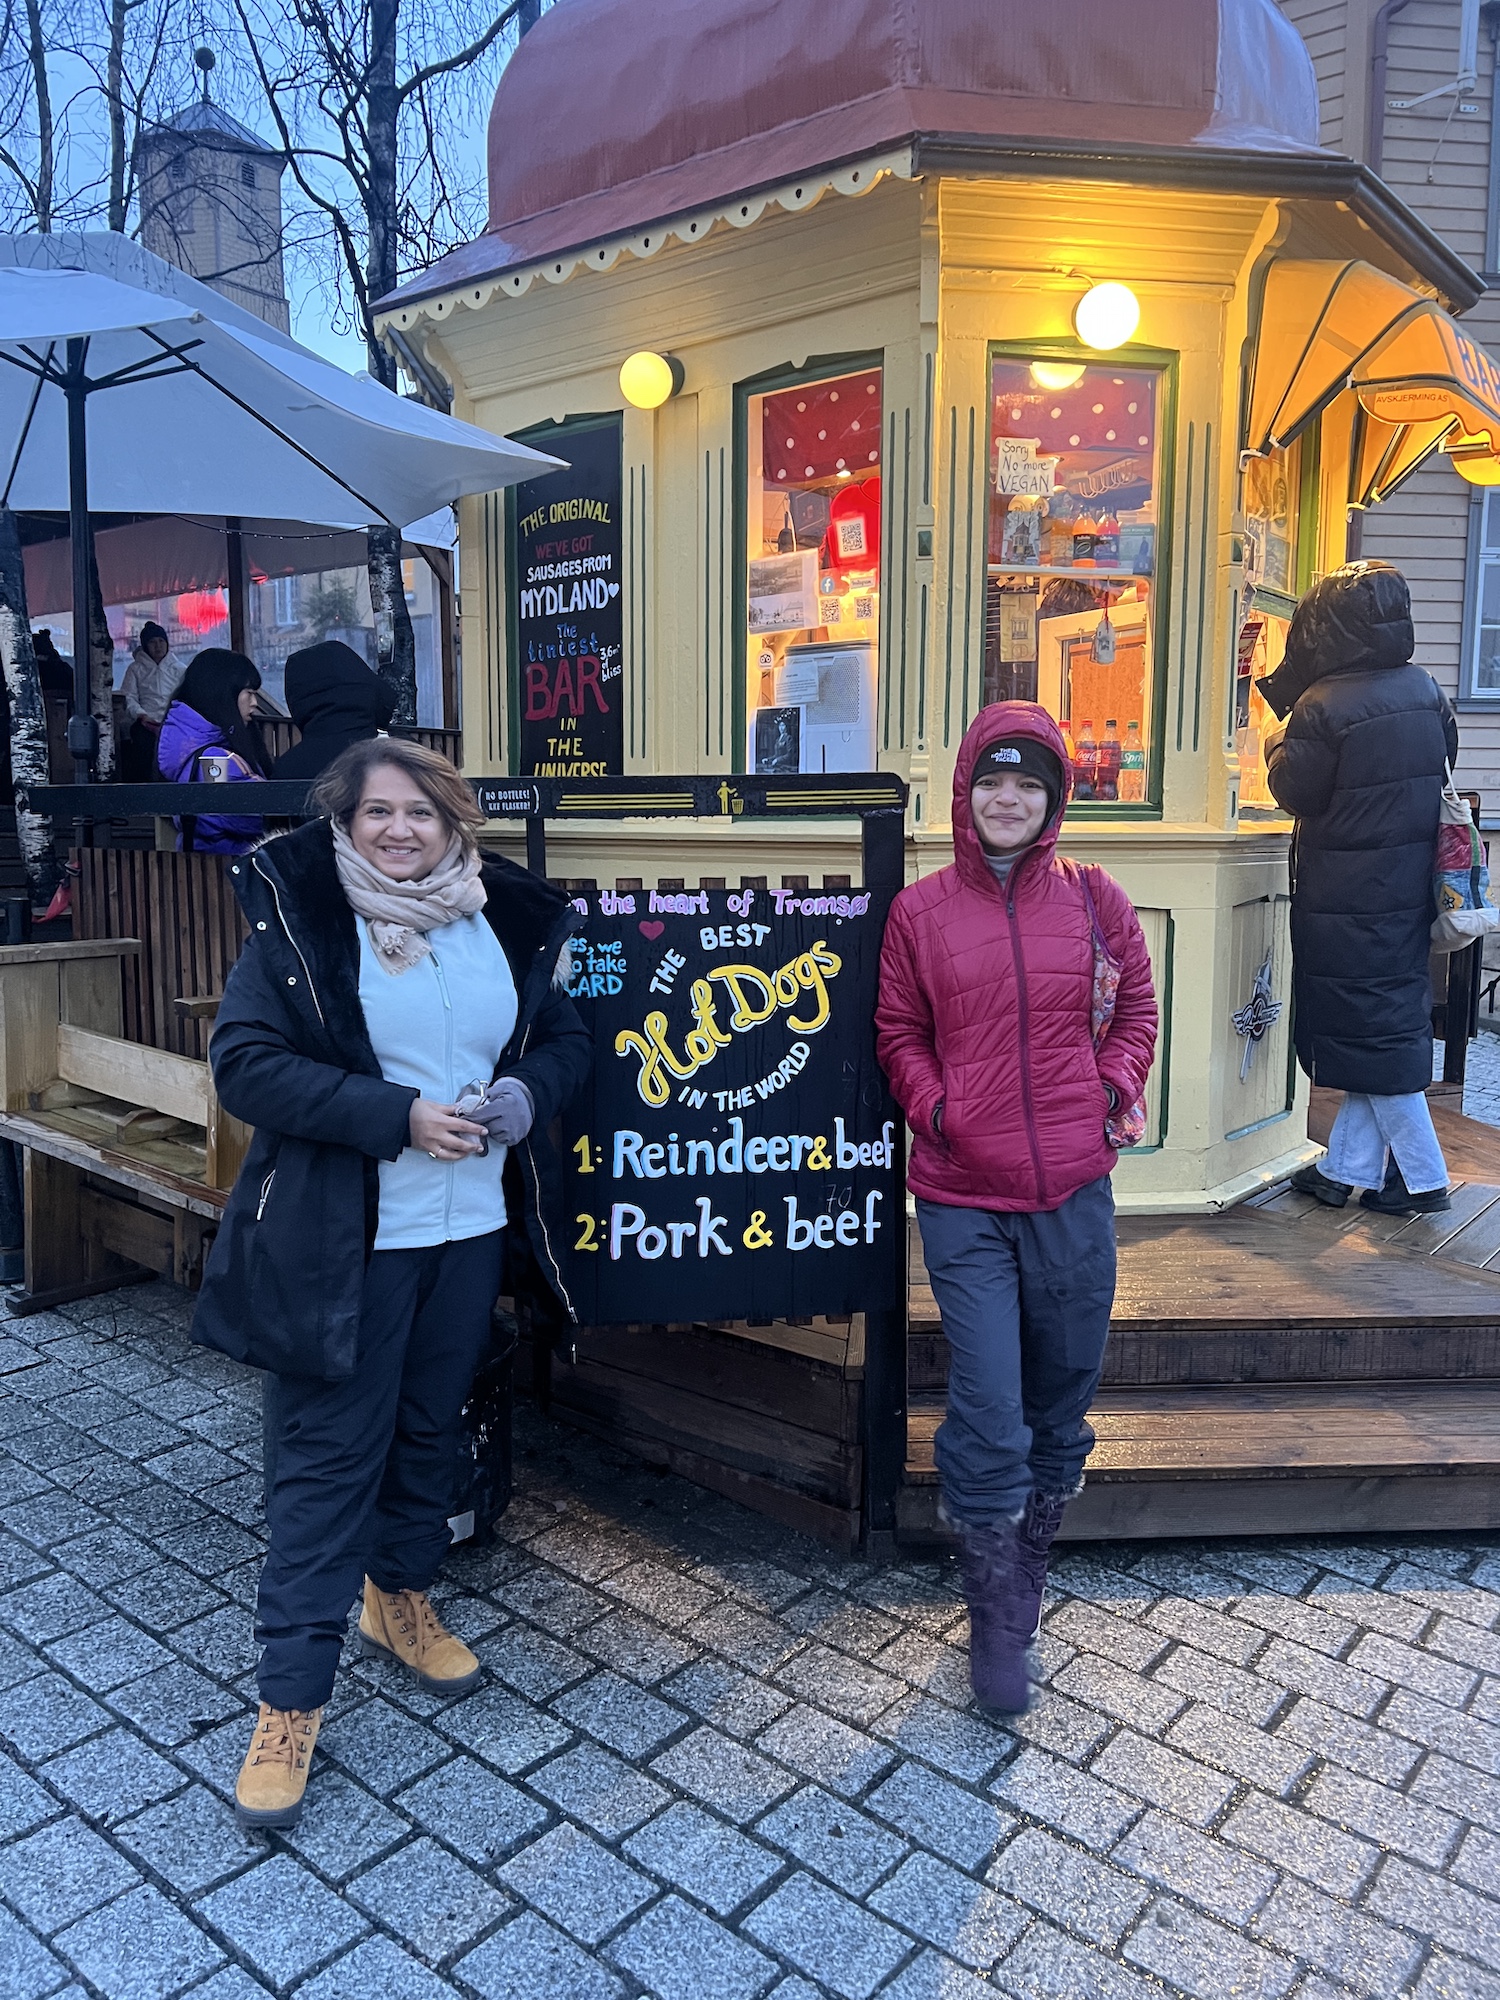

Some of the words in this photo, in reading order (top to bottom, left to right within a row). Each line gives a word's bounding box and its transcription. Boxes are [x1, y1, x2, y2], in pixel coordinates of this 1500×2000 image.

[1376, 393, 1436, 403] AVSKJERMING
[1437, 393, 1449, 402] AS
[1002, 440, 1029, 462] Sorry
[1002, 455, 1019, 471] No
[1023, 461, 1050, 471] more
[1000, 474, 1050, 493] VEGAN
[519, 506, 548, 537] THE
[549, 498, 611, 524] ORIGINAL
[535, 540, 570, 559] WE'VE
[571, 534, 594, 553] GOT
[526, 559, 582, 583] SAUSAGES
[582, 553, 612, 574] FROM
[520, 577, 609, 620] MYDLAND
[556, 623, 578, 638] The
[528, 632, 599, 662] tiniest
[602, 664, 622, 682] bliss
[524, 655, 609, 720] BAR
[560, 717, 577, 731] IN
[547, 737, 584, 757] THE
[1123, 752, 1144, 764] Spri
[533, 762, 608, 777] UNIVERSE
[497, 789, 530, 800] BOTTLES!
[598, 890, 636, 916] the
[649, 891, 709, 915] heart
[727, 889, 754, 917] of
[769, 889, 871, 918] Tromsø
[568, 937, 595, 955] es,
[597, 940, 622, 955] we
[572, 959, 583, 973] o
[586, 954, 627, 974] take
[649, 947, 687, 995] THE
[700, 923, 771, 951] BEST
[614, 979, 733, 1109] Hot
[706, 939, 842, 1034] Dogs
[677, 1085, 708, 1110] IN
[712, 1086, 756, 1112] THE
[754, 1041, 811, 1100] WORLD
[572, 1135, 603, 1173] 1:
[612, 1117, 812, 1178] Reindeer
[806, 1136, 833, 1170] &
[834, 1117, 895, 1170] beef
[574, 1214, 607, 1252] 2:
[610, 1197, 733, 1260] Pork
[742, 1210, 773, 1250] &
[783, 1190, 883, 1251] beef
